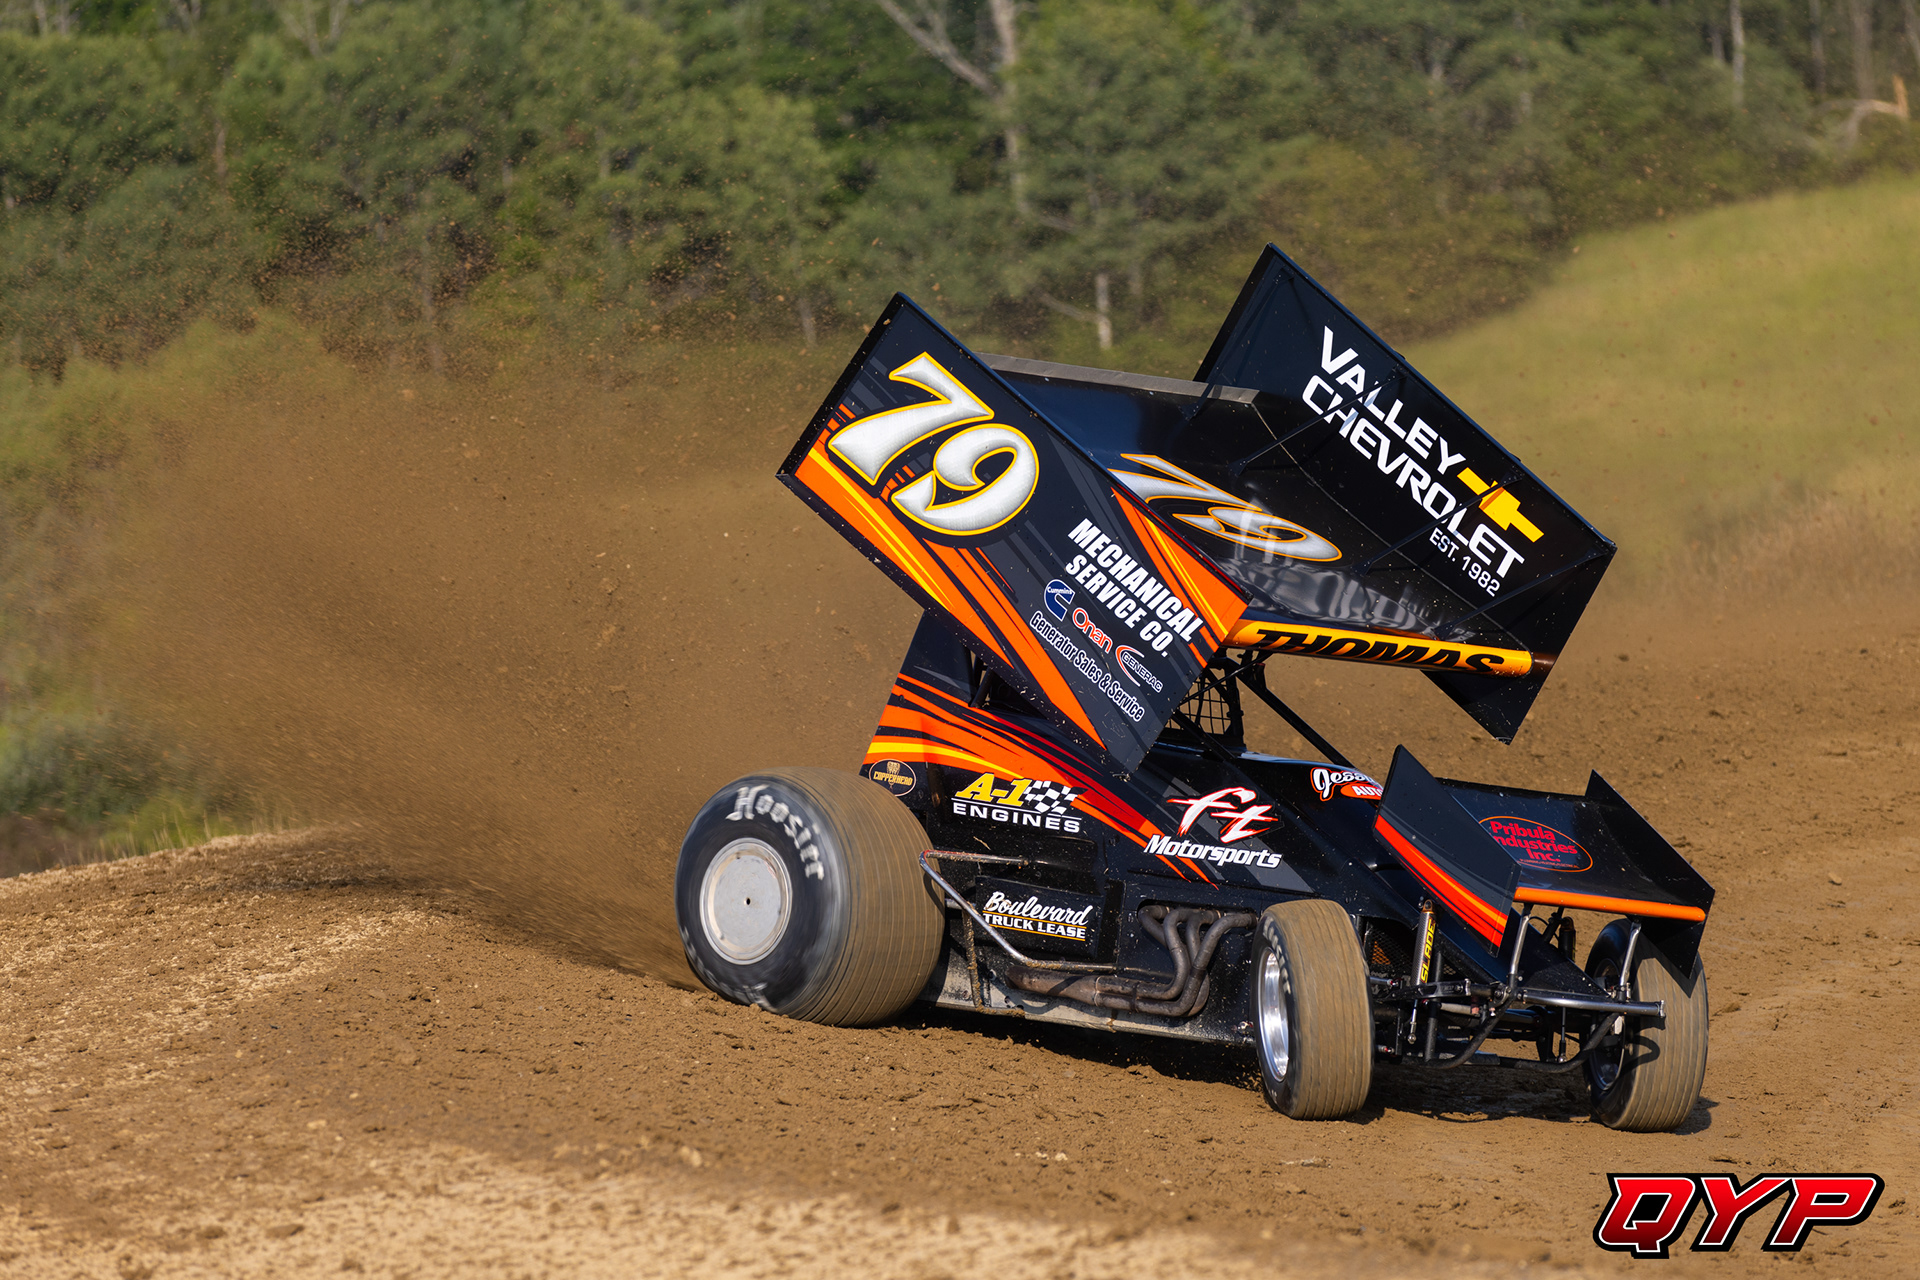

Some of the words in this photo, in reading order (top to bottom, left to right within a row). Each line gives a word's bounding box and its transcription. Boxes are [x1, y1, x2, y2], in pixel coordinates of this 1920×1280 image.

[1321, 325, 1467, 475] VALLEY
[828, 351, 1040, 536] 79
[1302, 374, 1525, 578] CHEVROLET
[1107, 453, 1343, 562] 79
[1067, 518, 1204, 642] MECHANICAL
[1429, 527, 1459, 562] EST.
[1461, 556, 1501, 597] 1982
[1065, 554, 1147, 629] SERVICE
[1139, 620, 1174, 658] CO.
[1072, 607, 1113, 654] Onan
[1252, 628, 1505, 674] THOMAS
[1030, 610, 1080, 662] Generator
[1073, 650, 1101, 684] Sales
[1098, 673, 1112, 694] &
[1107, 681, 1145, 722] Service
[1121, 651, 1164, 693] GENERAC
[954, 772, 1034, 807] A-1
[953, 801, 1081, 834] ENGINES
[1489, 820, 1557, 841] Pribula
[1143, 834, 1282, 869] Motorsports
[1490, 833, 1578, 855] ndustries
[1525, 848, 1562, 863] Inc.
[982, 912, 1034, 931] TRUCK
[1037, 921, 1087, 939] LEASE
[983, 891, 1094, 926] Boulevard
